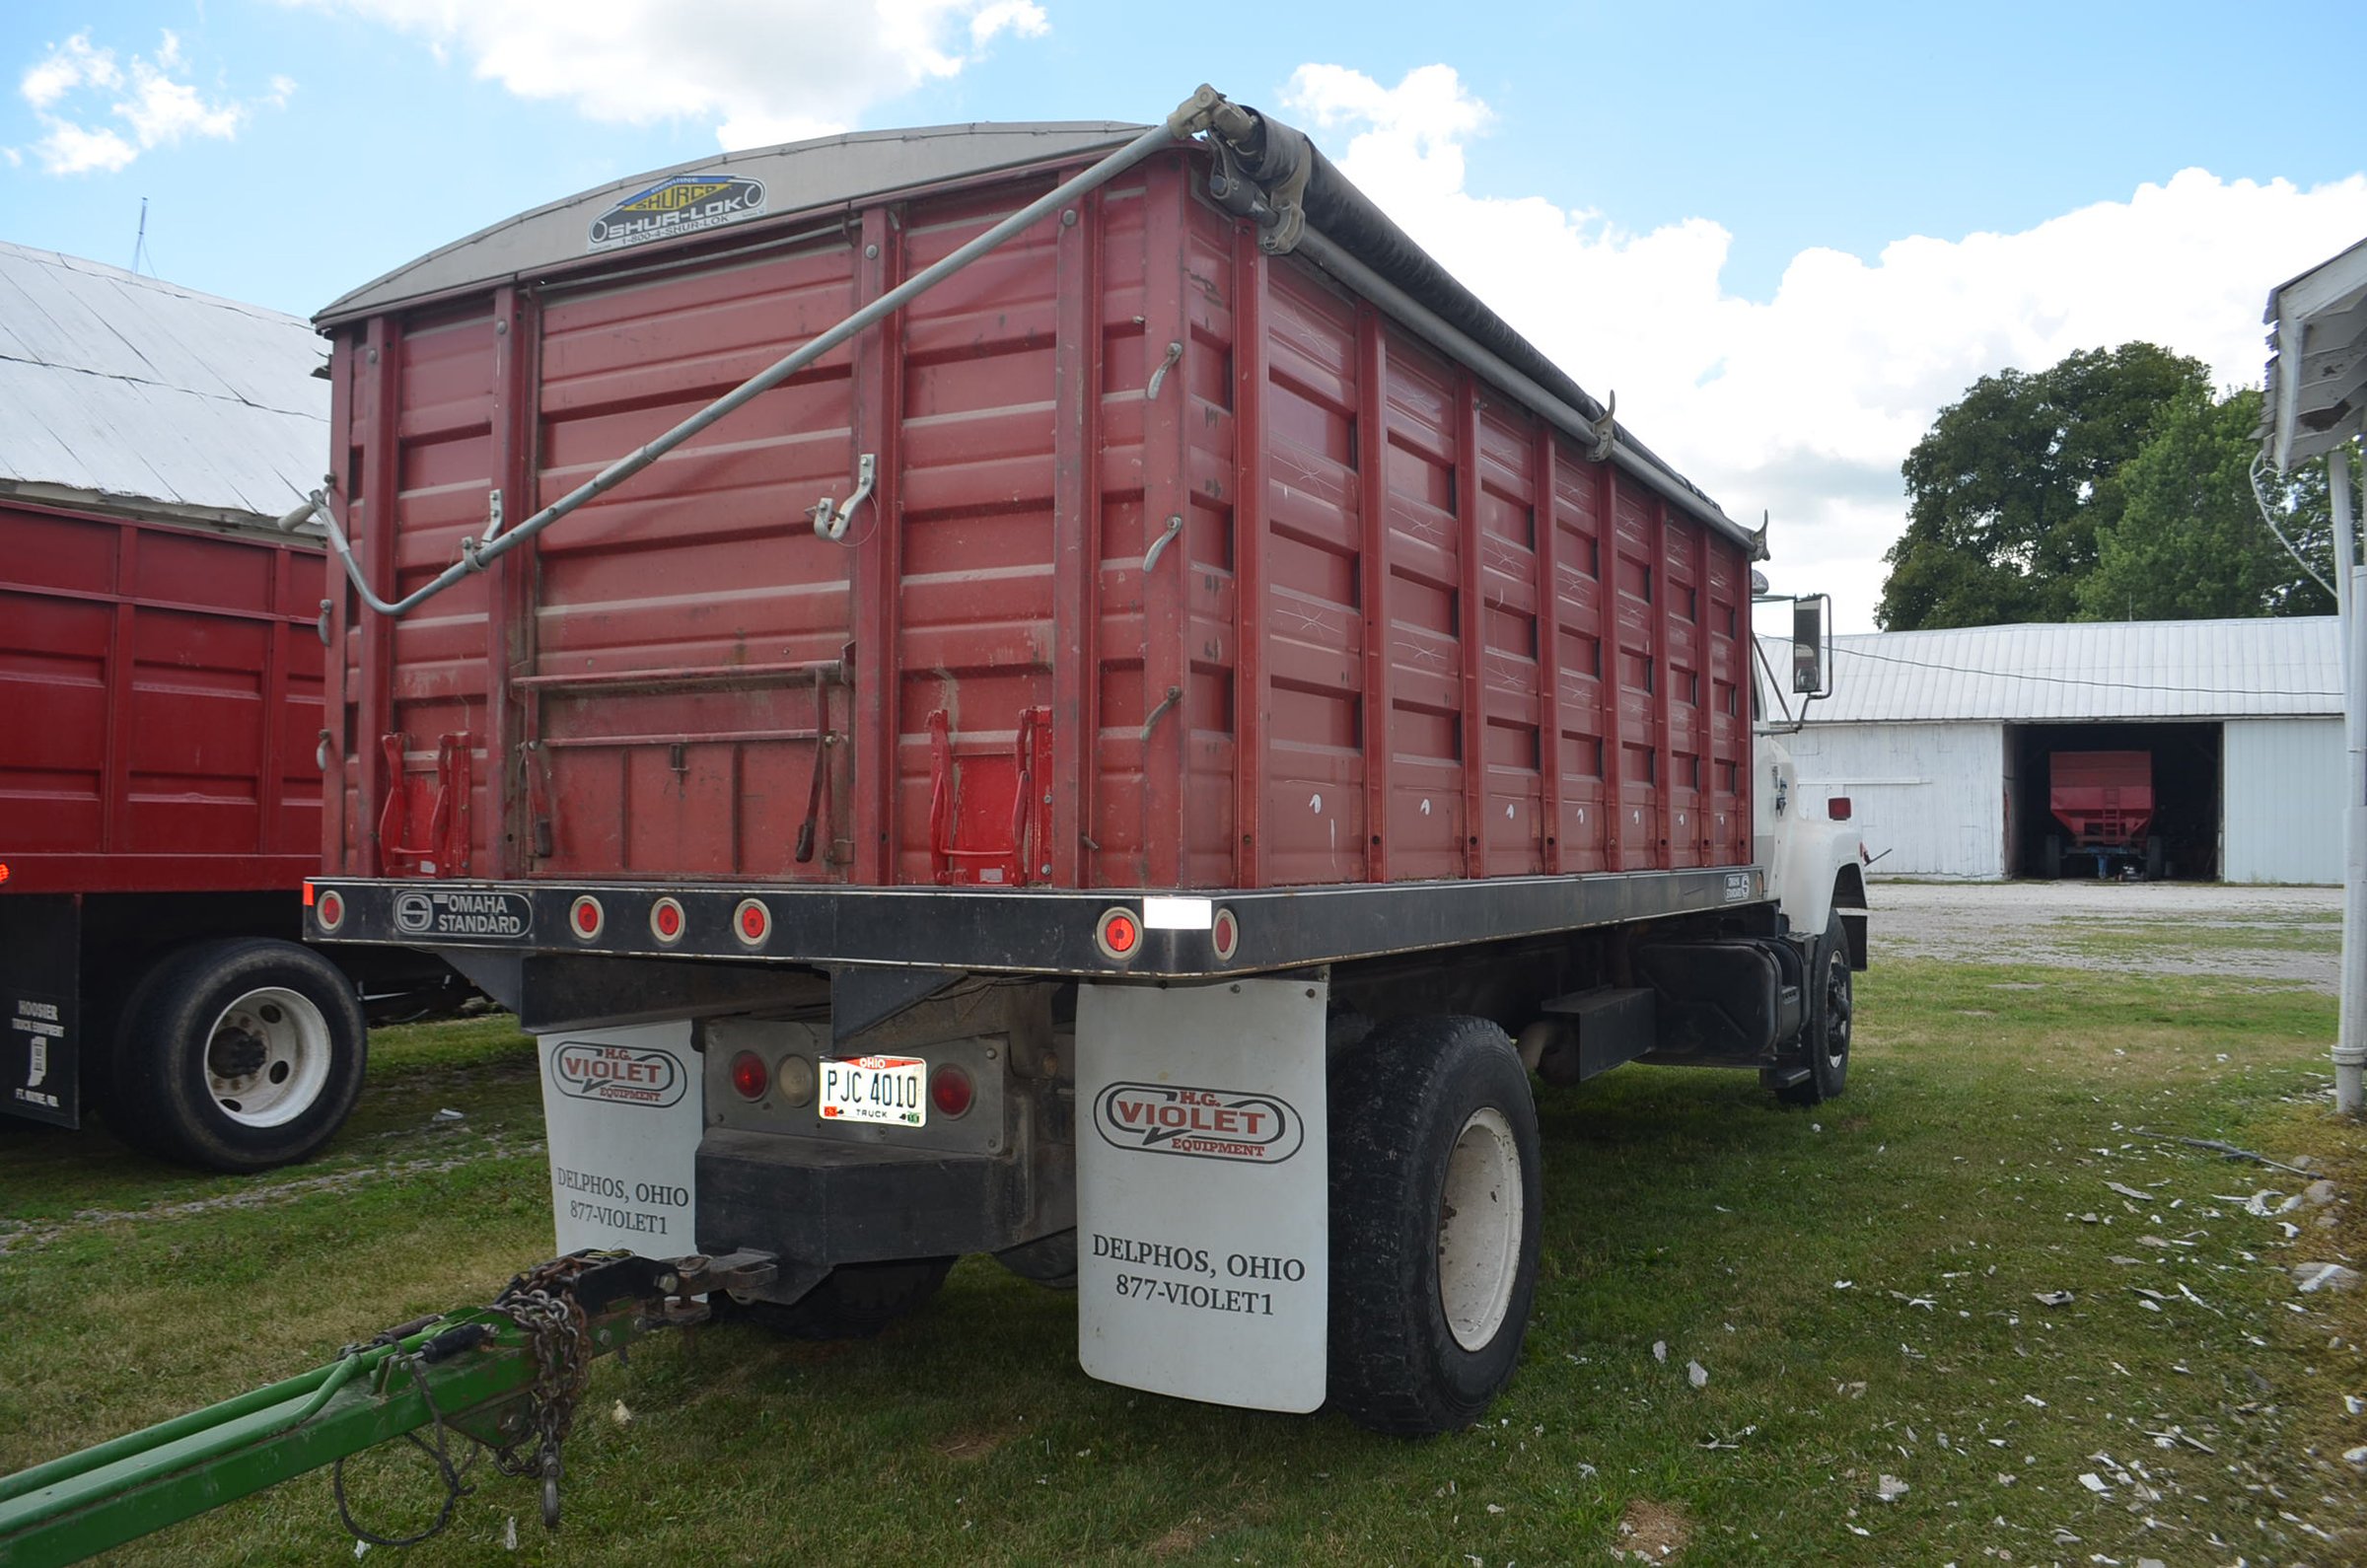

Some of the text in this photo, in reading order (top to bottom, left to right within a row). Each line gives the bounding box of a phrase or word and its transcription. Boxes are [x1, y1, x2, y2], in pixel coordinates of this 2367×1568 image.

[608, 196, 743, 239] SHUR-LOK
[621, 214, 730, 246] 1-800-4-SHUR-LOK
[448, 895, 508, 913] OMAHA
[438, 914, 521, 934] STANDARD
[605, 1047, 632, 1062] H.G.
[859, 1056, 886, 1069] OHIO
[564, 1056, 662, 1084] VIOLET
[600, 1087, 661, 1103] EQUIPMENT
[827, 1069, 917, 1109] PJC 4010
[1180, 1091, 1222, 1107] H.G.
[856, 1107, 888, 1118] TRUCK
[1116, 1100, 1266, 1135] VIOLET
[1171, 1138, 1265, 1157] EQUIPMENT
[557, 1167, 689, 1208] DELPHOS, OHIO
[569, 1199, 668, 1235] 877-VIOLET1
[1092, 1233, 1306, 1282] DELPHOS, OHIO
[1115, 1273, 1274, 1316] 877-VIOLET1
